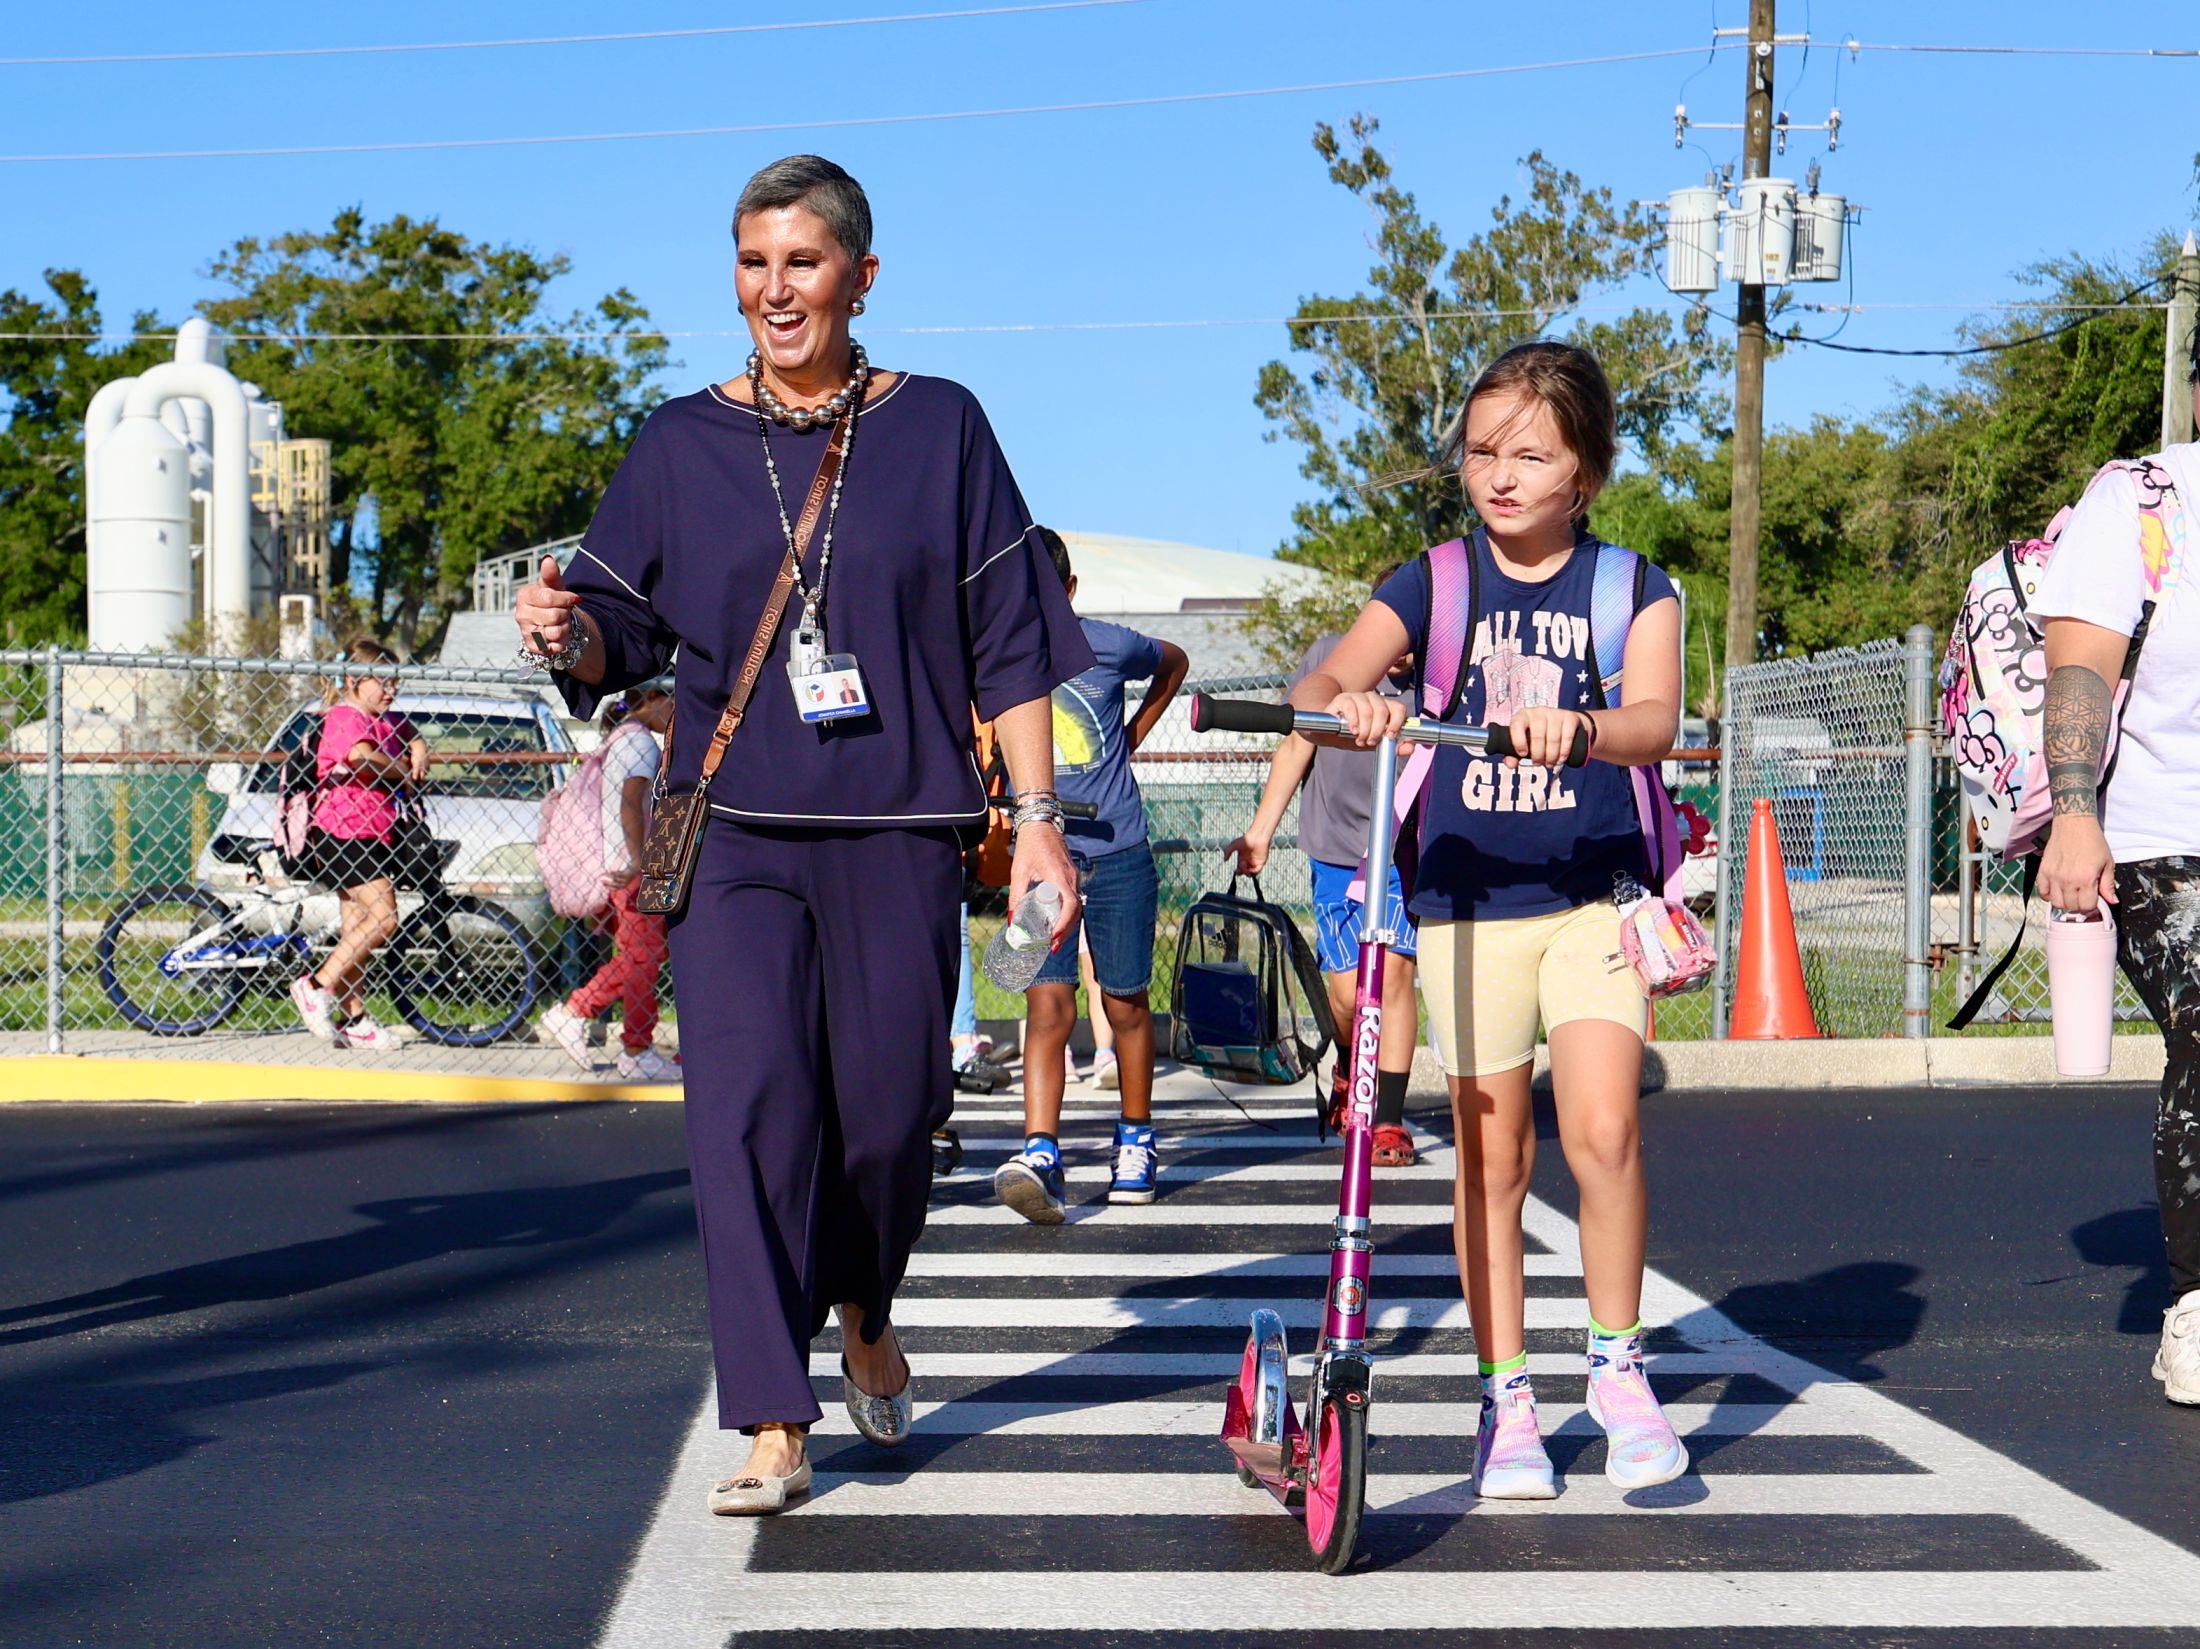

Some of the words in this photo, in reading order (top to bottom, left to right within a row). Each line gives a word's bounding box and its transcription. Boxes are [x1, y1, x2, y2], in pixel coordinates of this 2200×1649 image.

[1469, 610, 1523, 666] ALL
[1462, 759, 1577, 812] GIRL
[1354, 1006, 1382, 1126] Razor
